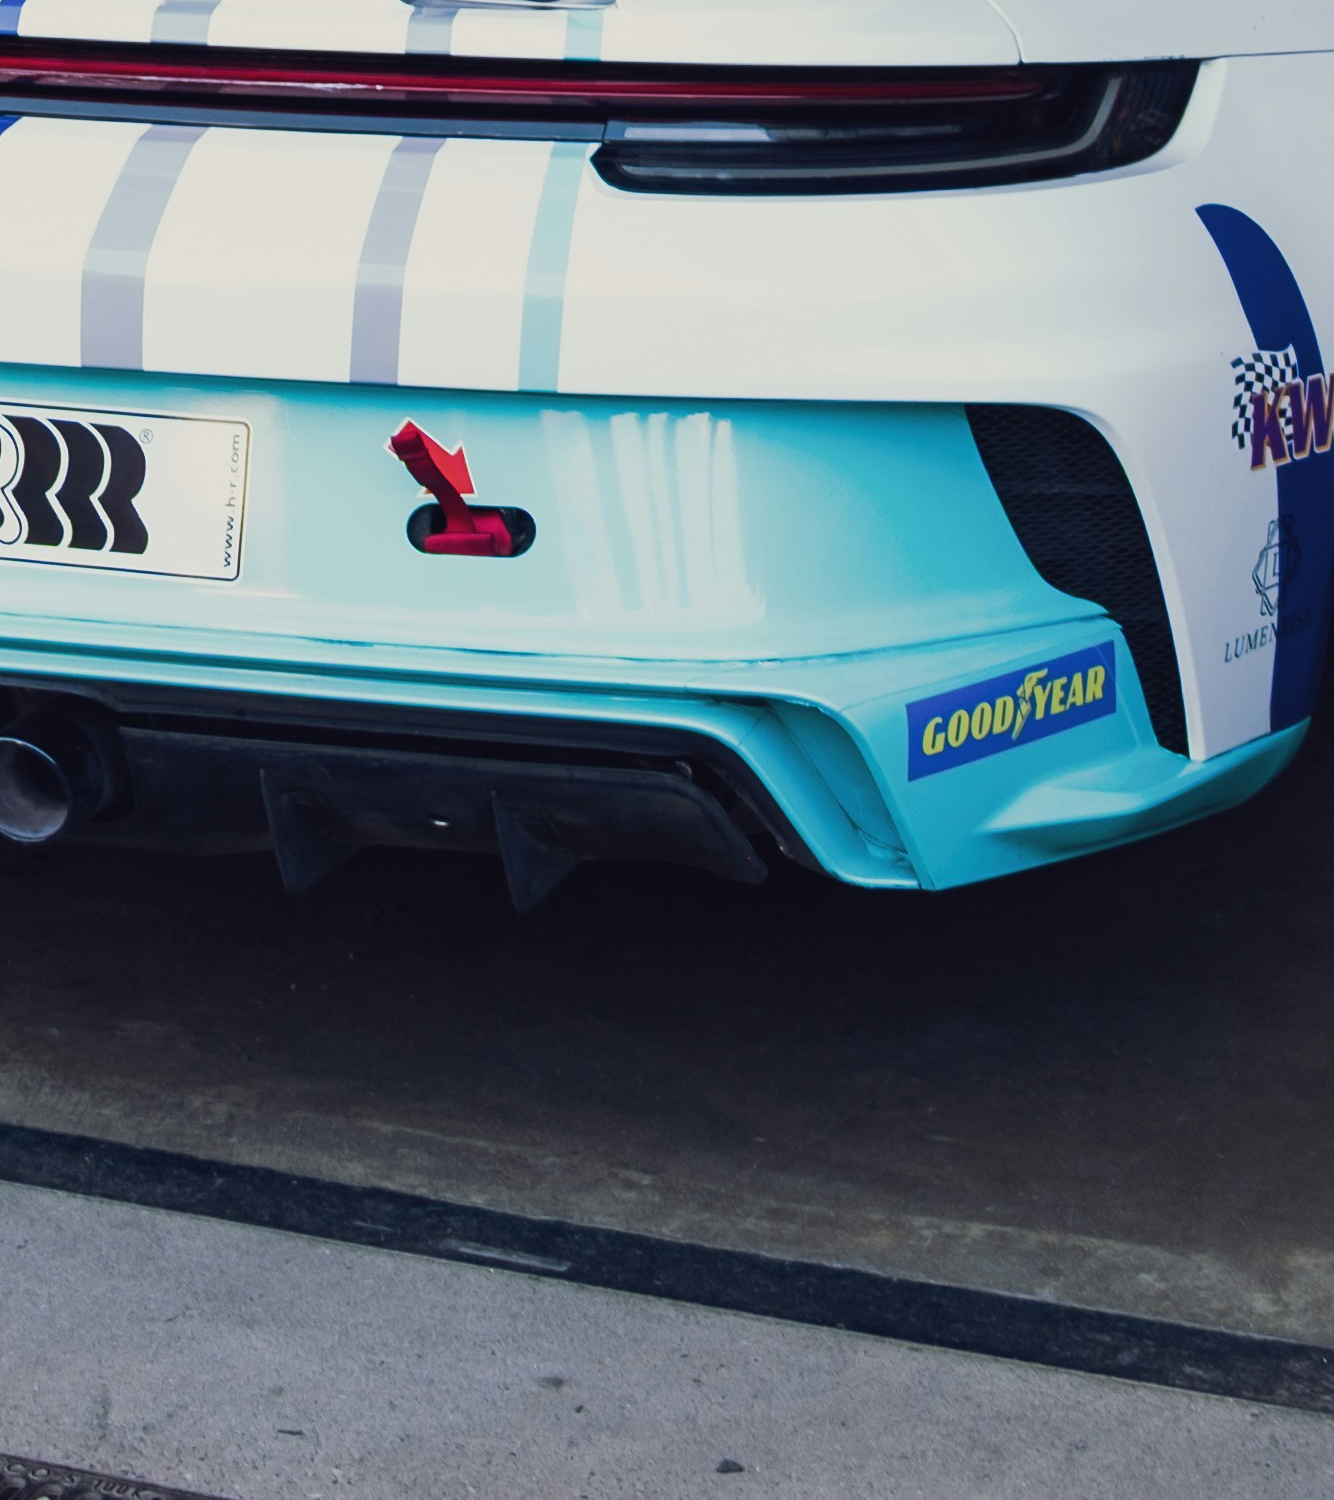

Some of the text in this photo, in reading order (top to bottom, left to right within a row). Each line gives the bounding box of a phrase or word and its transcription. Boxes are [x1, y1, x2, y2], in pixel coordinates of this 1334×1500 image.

[223, 434, 240, 568] www.h-r.com
[1224, 609, 1312, 663] LUMENRISE
[922, 664, 1106, 757] GOODYEAR
